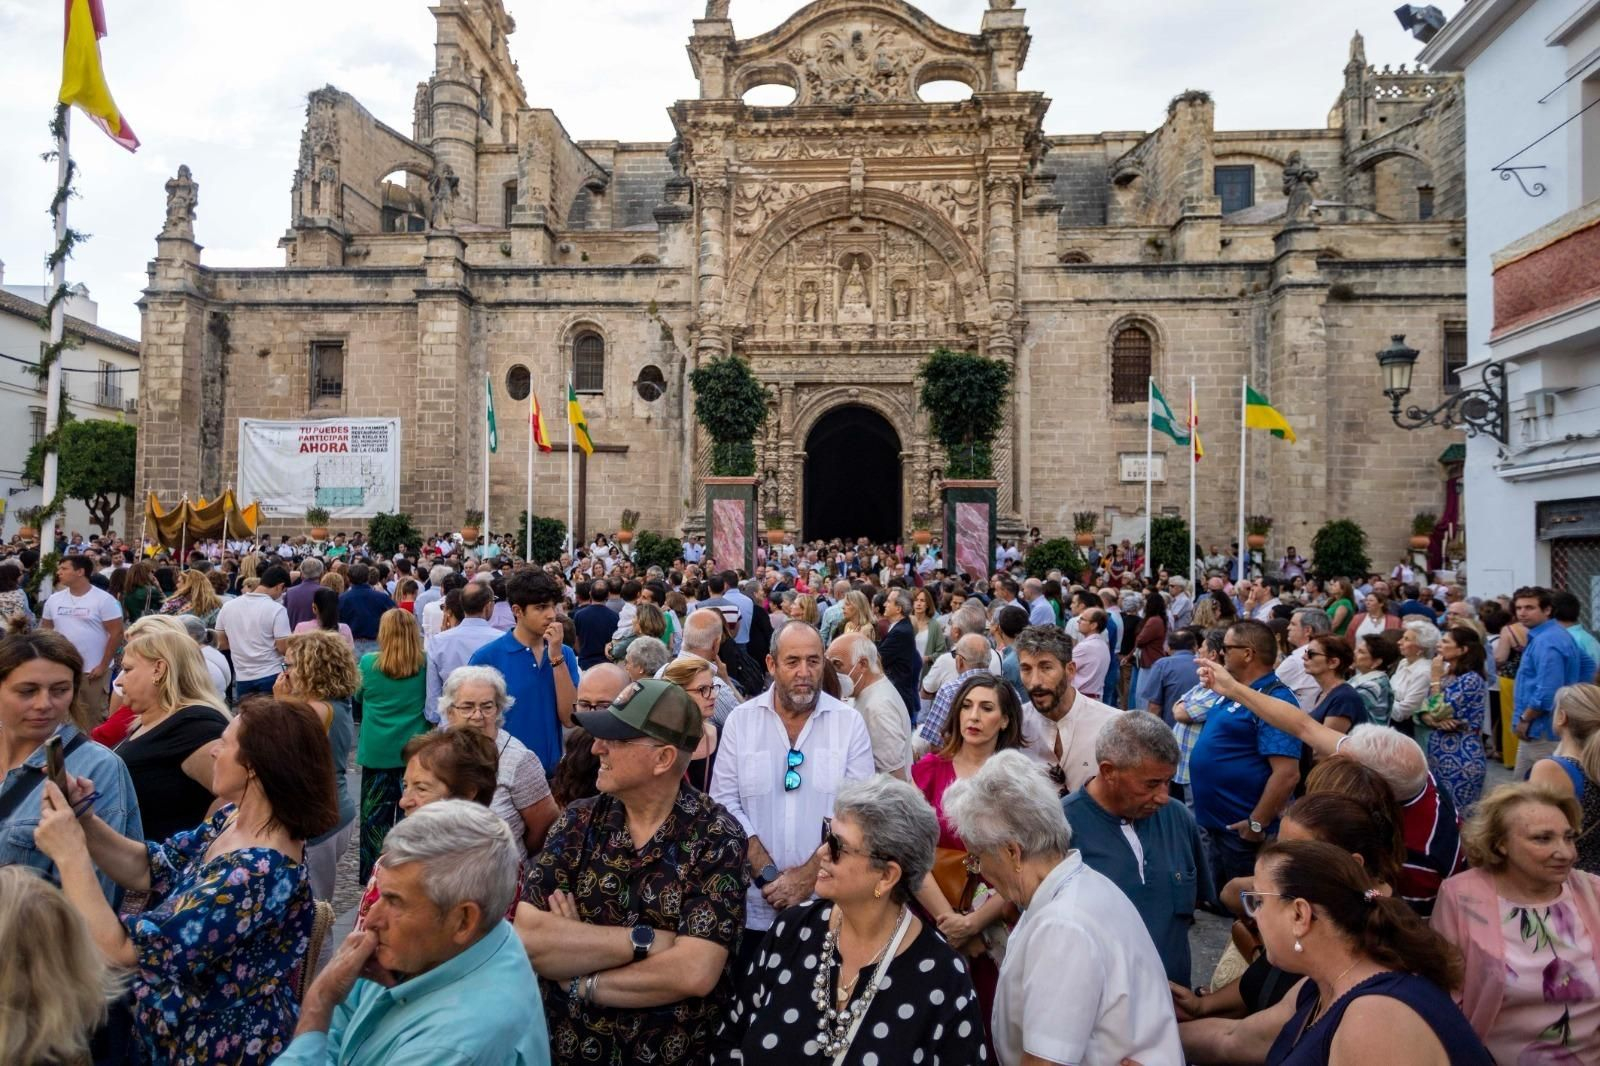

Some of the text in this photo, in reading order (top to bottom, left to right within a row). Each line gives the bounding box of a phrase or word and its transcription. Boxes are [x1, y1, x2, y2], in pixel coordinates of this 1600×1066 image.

[300, 426, 349, 434] TU PUEDES
[298, 434, 349, 442] PARTICIPAR
[299, 442, 349, 453] AHORA
